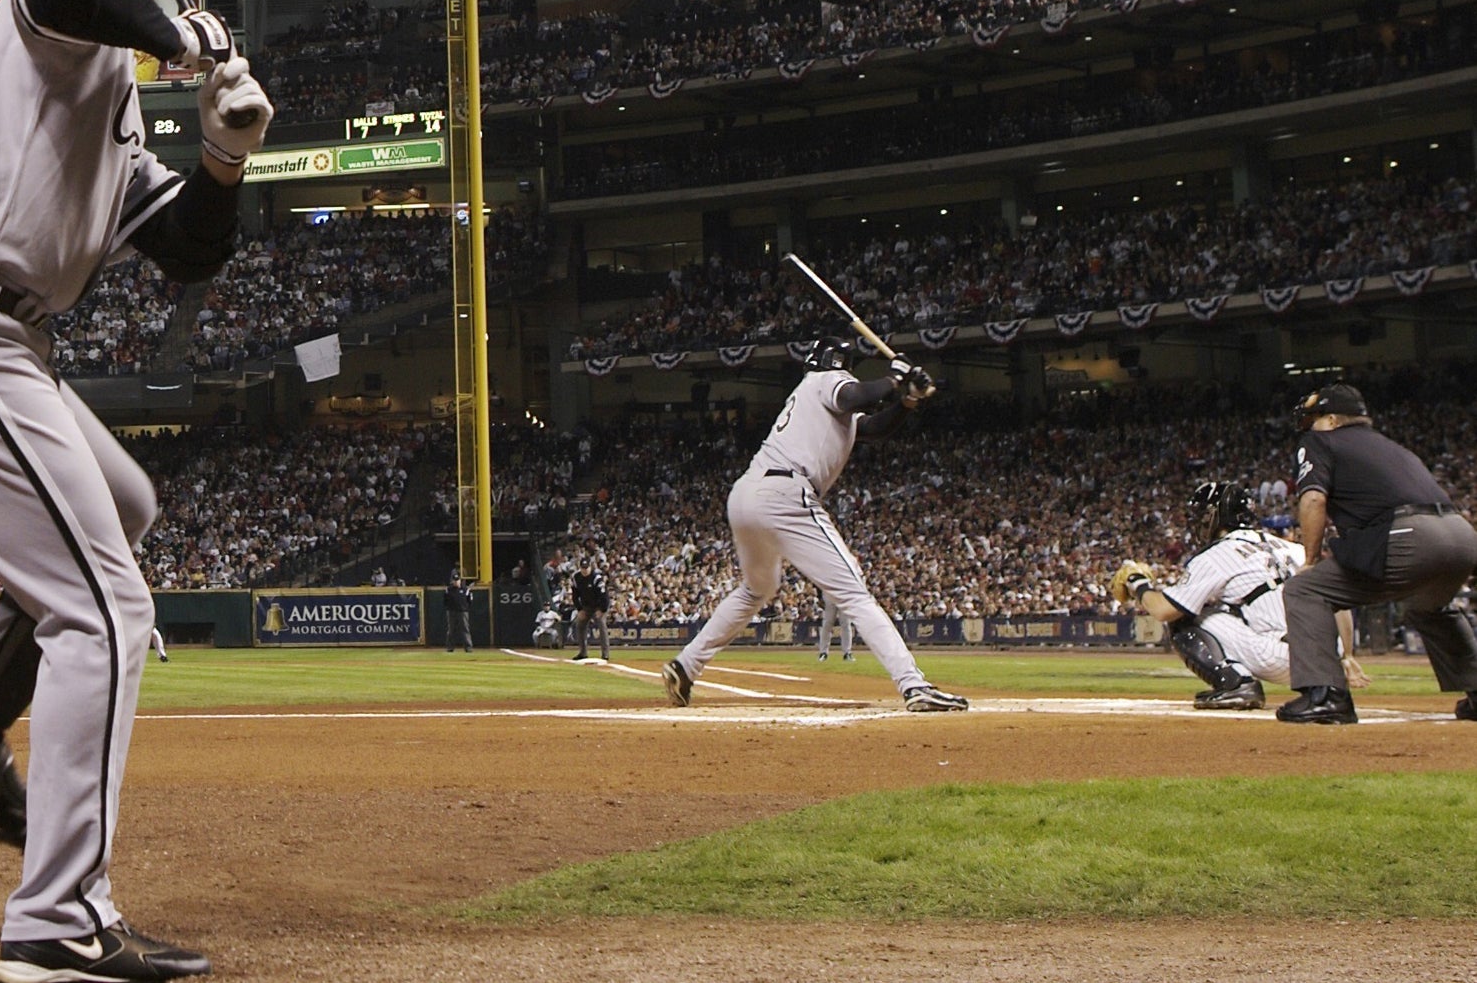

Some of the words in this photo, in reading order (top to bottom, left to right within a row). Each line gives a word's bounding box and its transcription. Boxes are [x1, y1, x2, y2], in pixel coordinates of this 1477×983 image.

[419, 110, 445, 121] TOTAL
[361, 126, 369, 139] 7
[394, 122, 402, 136] 7
[425, 119, 440, 133] 14
[244, 155, 309, 176] dministaff
[376, 156, 432, 166] MANAGEMENT
[500, 592, 533, 604] 326
[288, 604, 414, 624] AMERIQUEST
[291, 625, 352, 634] MORTGAGE
[356, 624, 410, 633] COMPANY
